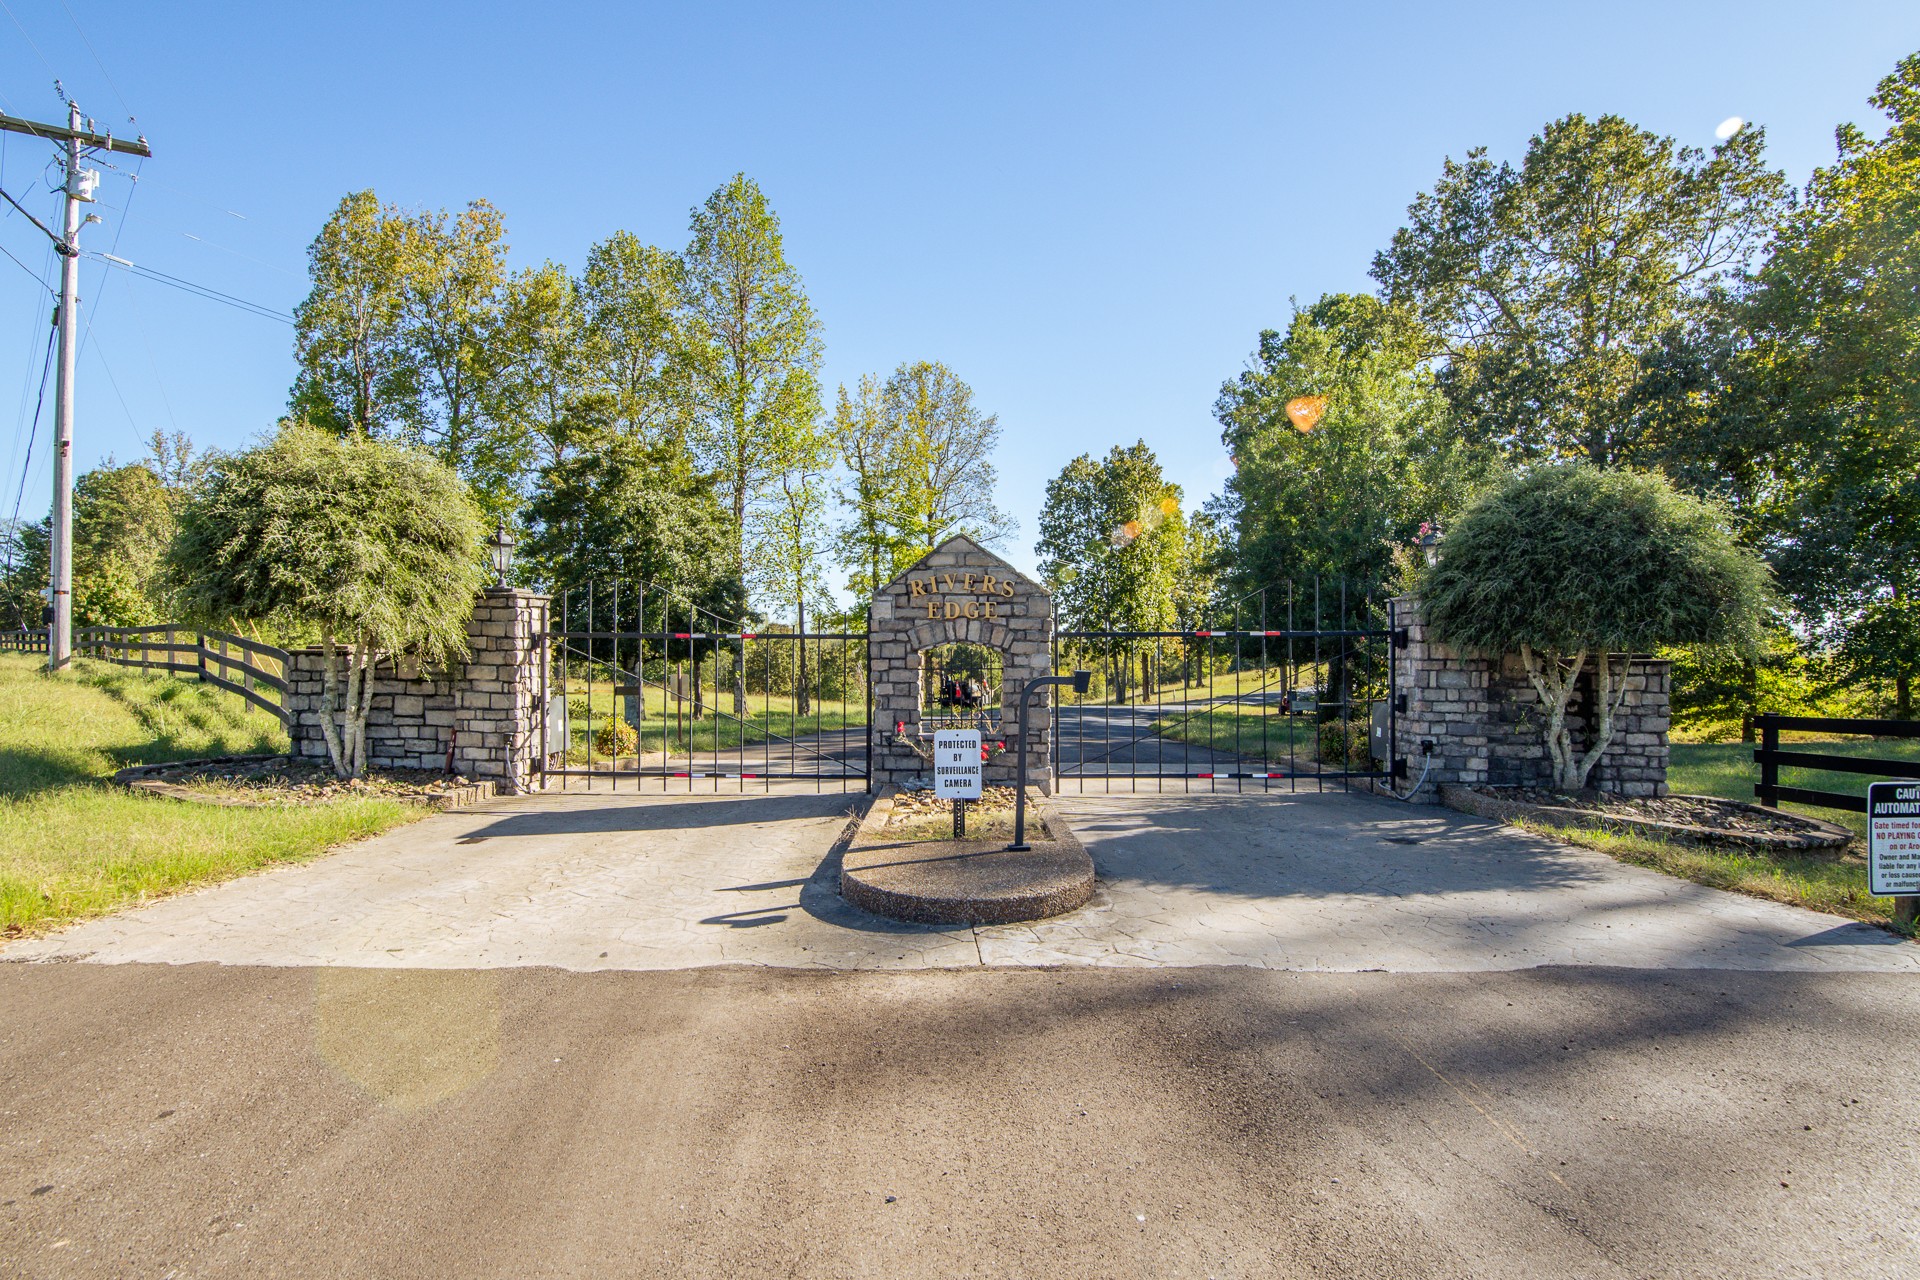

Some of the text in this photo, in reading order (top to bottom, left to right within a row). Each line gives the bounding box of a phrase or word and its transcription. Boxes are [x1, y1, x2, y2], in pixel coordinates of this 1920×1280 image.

[910, 572, 1015, 598] RIVERS
[927, 601, 998, 619] EDGE
[938, 740, 977, 749] PROTECTED
[953, 753, 962, 761] BY
[937, 766, 979, 775] SURVEILLANCE
[944, 779, 972, 787] CAMERA
[1874, 821, 1889, 829] Gate
[1891, 821, 1909, 829] timed
[1887, 831, 1915, 839] PLAYING
